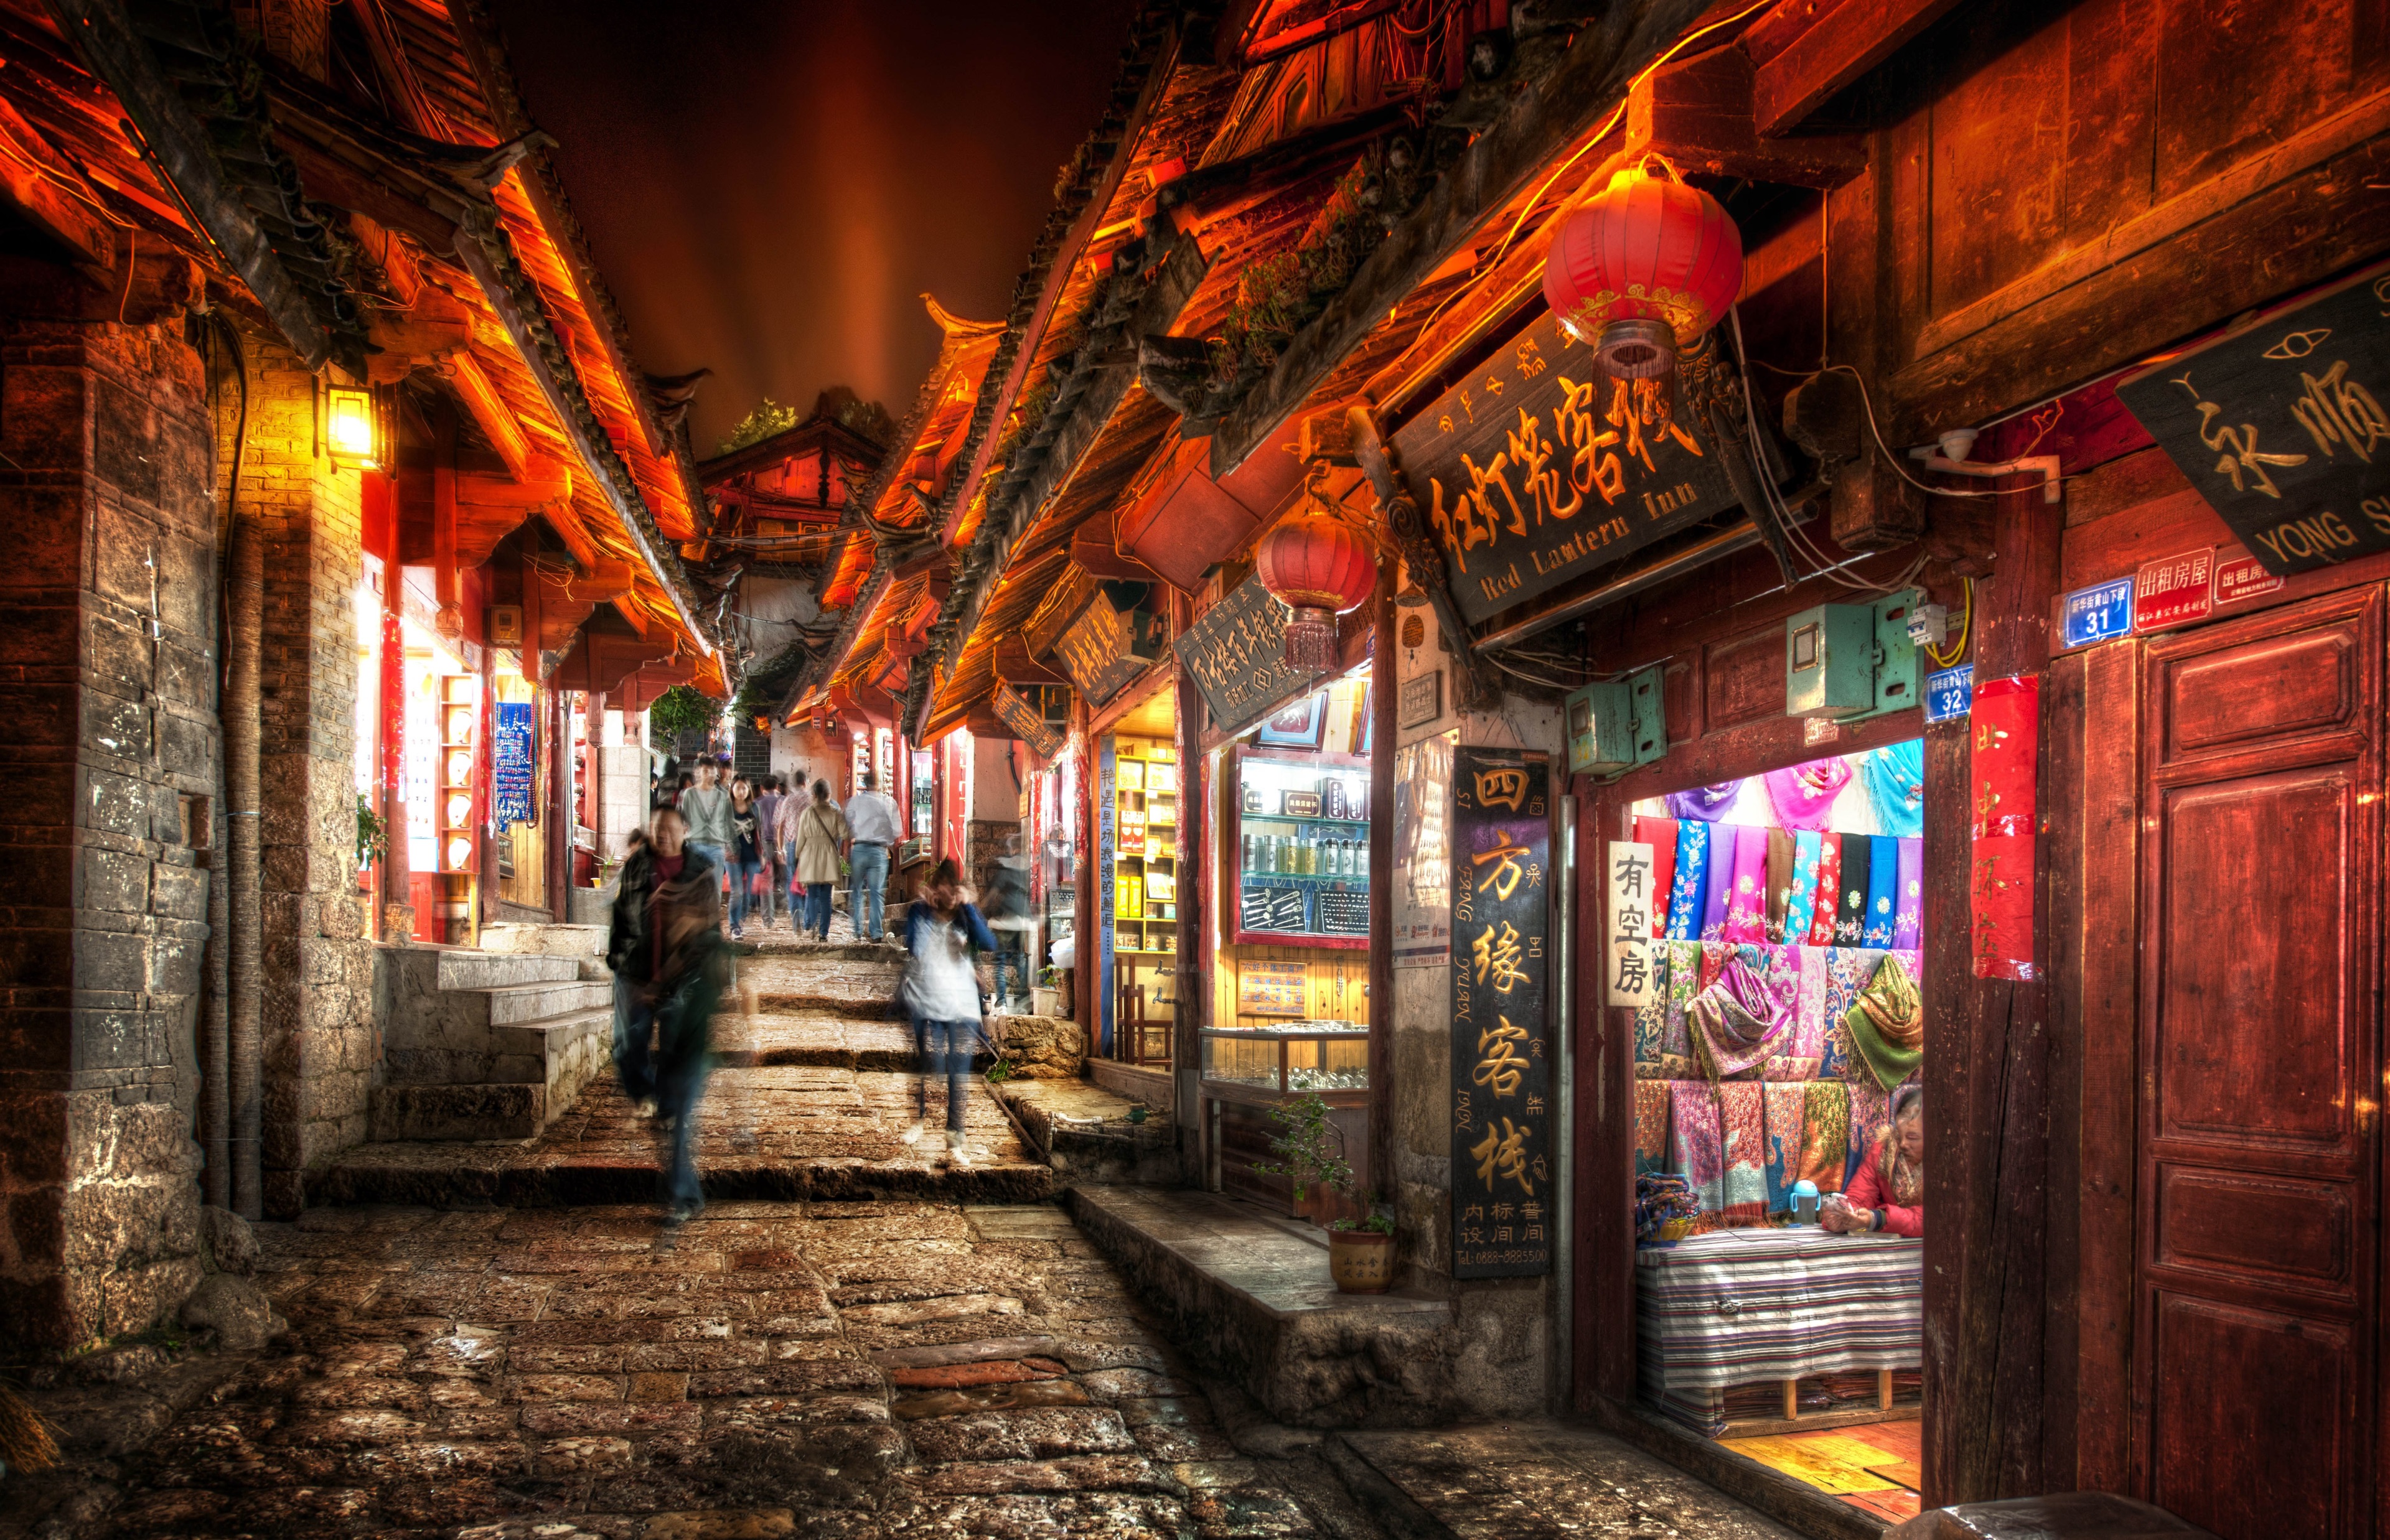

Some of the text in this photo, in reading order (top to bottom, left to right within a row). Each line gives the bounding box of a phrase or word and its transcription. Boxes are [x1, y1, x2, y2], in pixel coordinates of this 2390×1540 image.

[1479, 482, 1698, 602] Red Lantern Inn
[2255, 511, 2358, 562] YONG
[2139, 556, 2208, 598] 出租房屋
[2086, 608, 2108, 633] 31
[1942, 689, 1961, 711] 32
[1614, 854, 1649, 994] 有空房
[1454, 788, 1473, 1134] SI FANG YUAN INN
[1491, 1201, 1514, 1243] 标间
[1520, 1200, 1544, 1243] 普间
